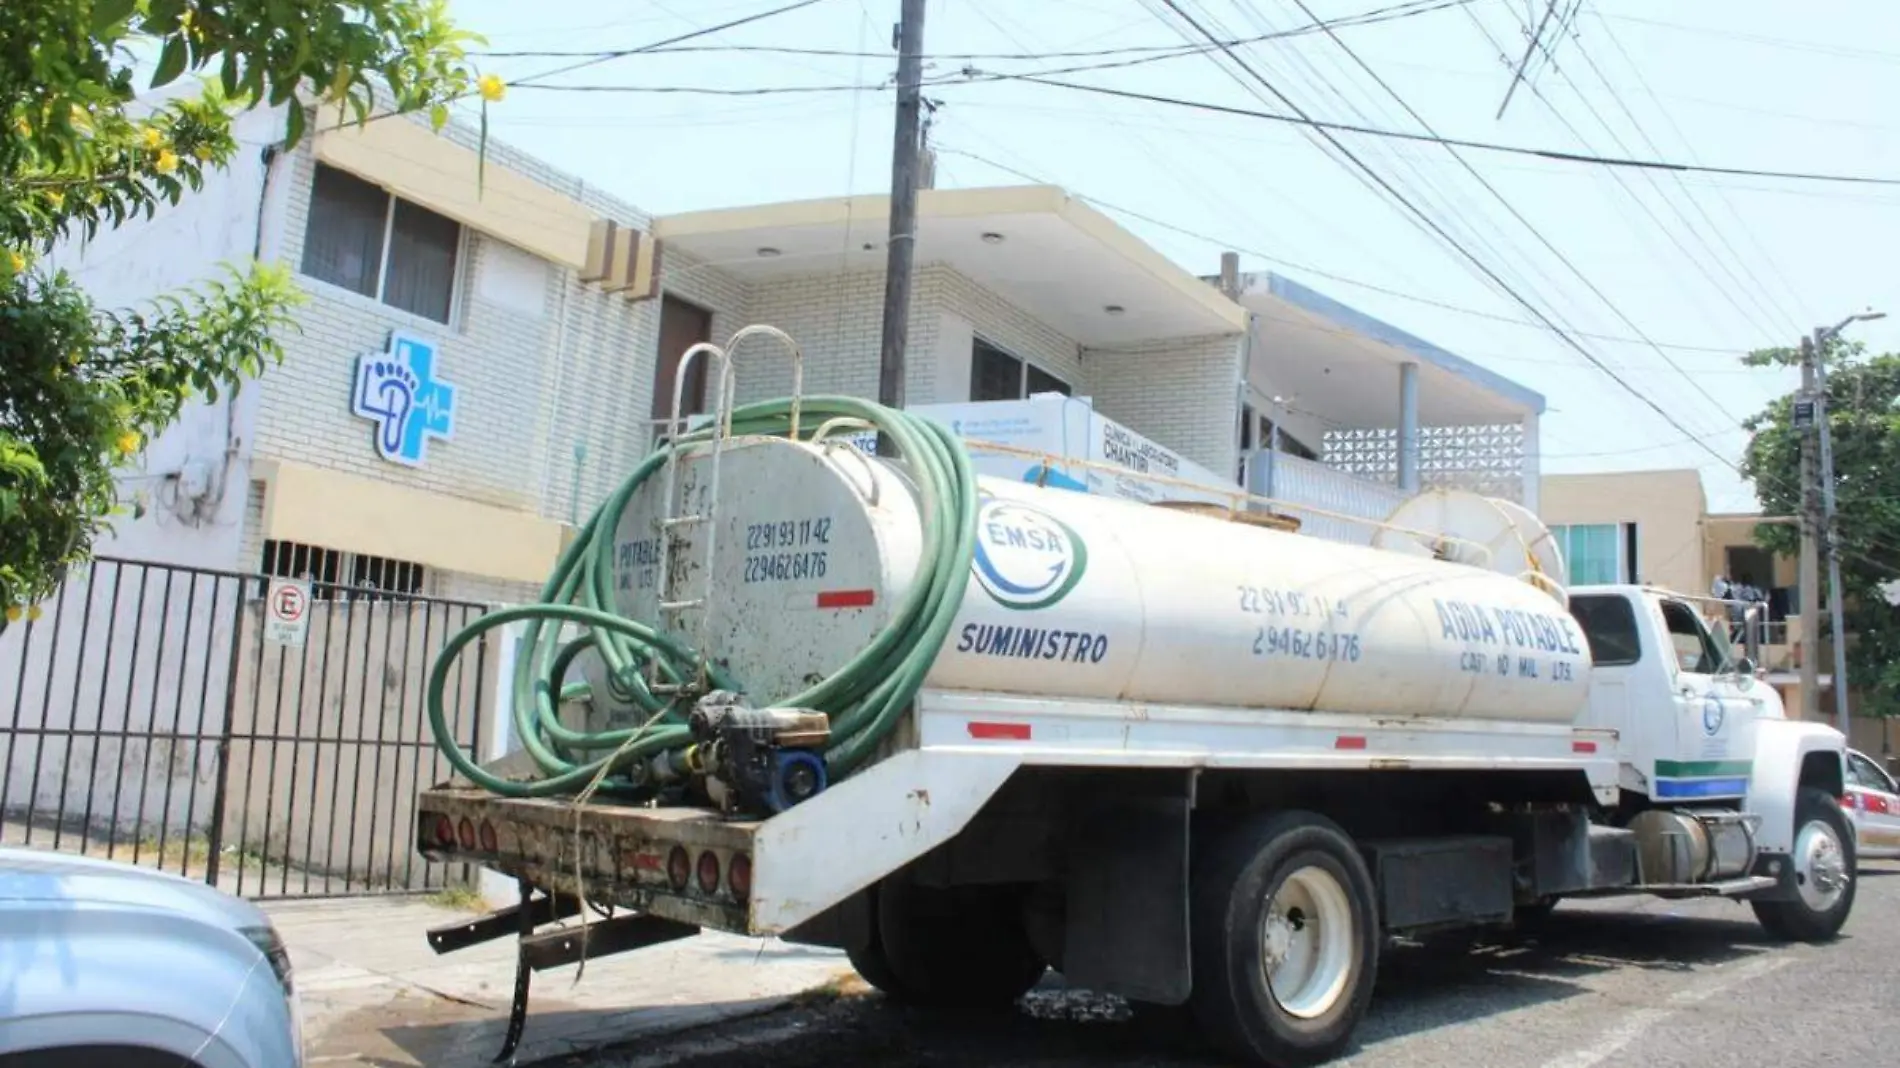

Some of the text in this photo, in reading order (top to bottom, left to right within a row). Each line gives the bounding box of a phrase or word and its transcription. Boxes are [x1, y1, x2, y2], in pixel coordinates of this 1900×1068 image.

[986, 522, 1064, 555] EMSA
[743, 551, 827, 584] 2294626476
[957, 622, 1108, 664] SUMINISTRO
[1432, 598, 1580, 655] AGUA POTABLE
[1518, 655, 1539, 678] MIL
